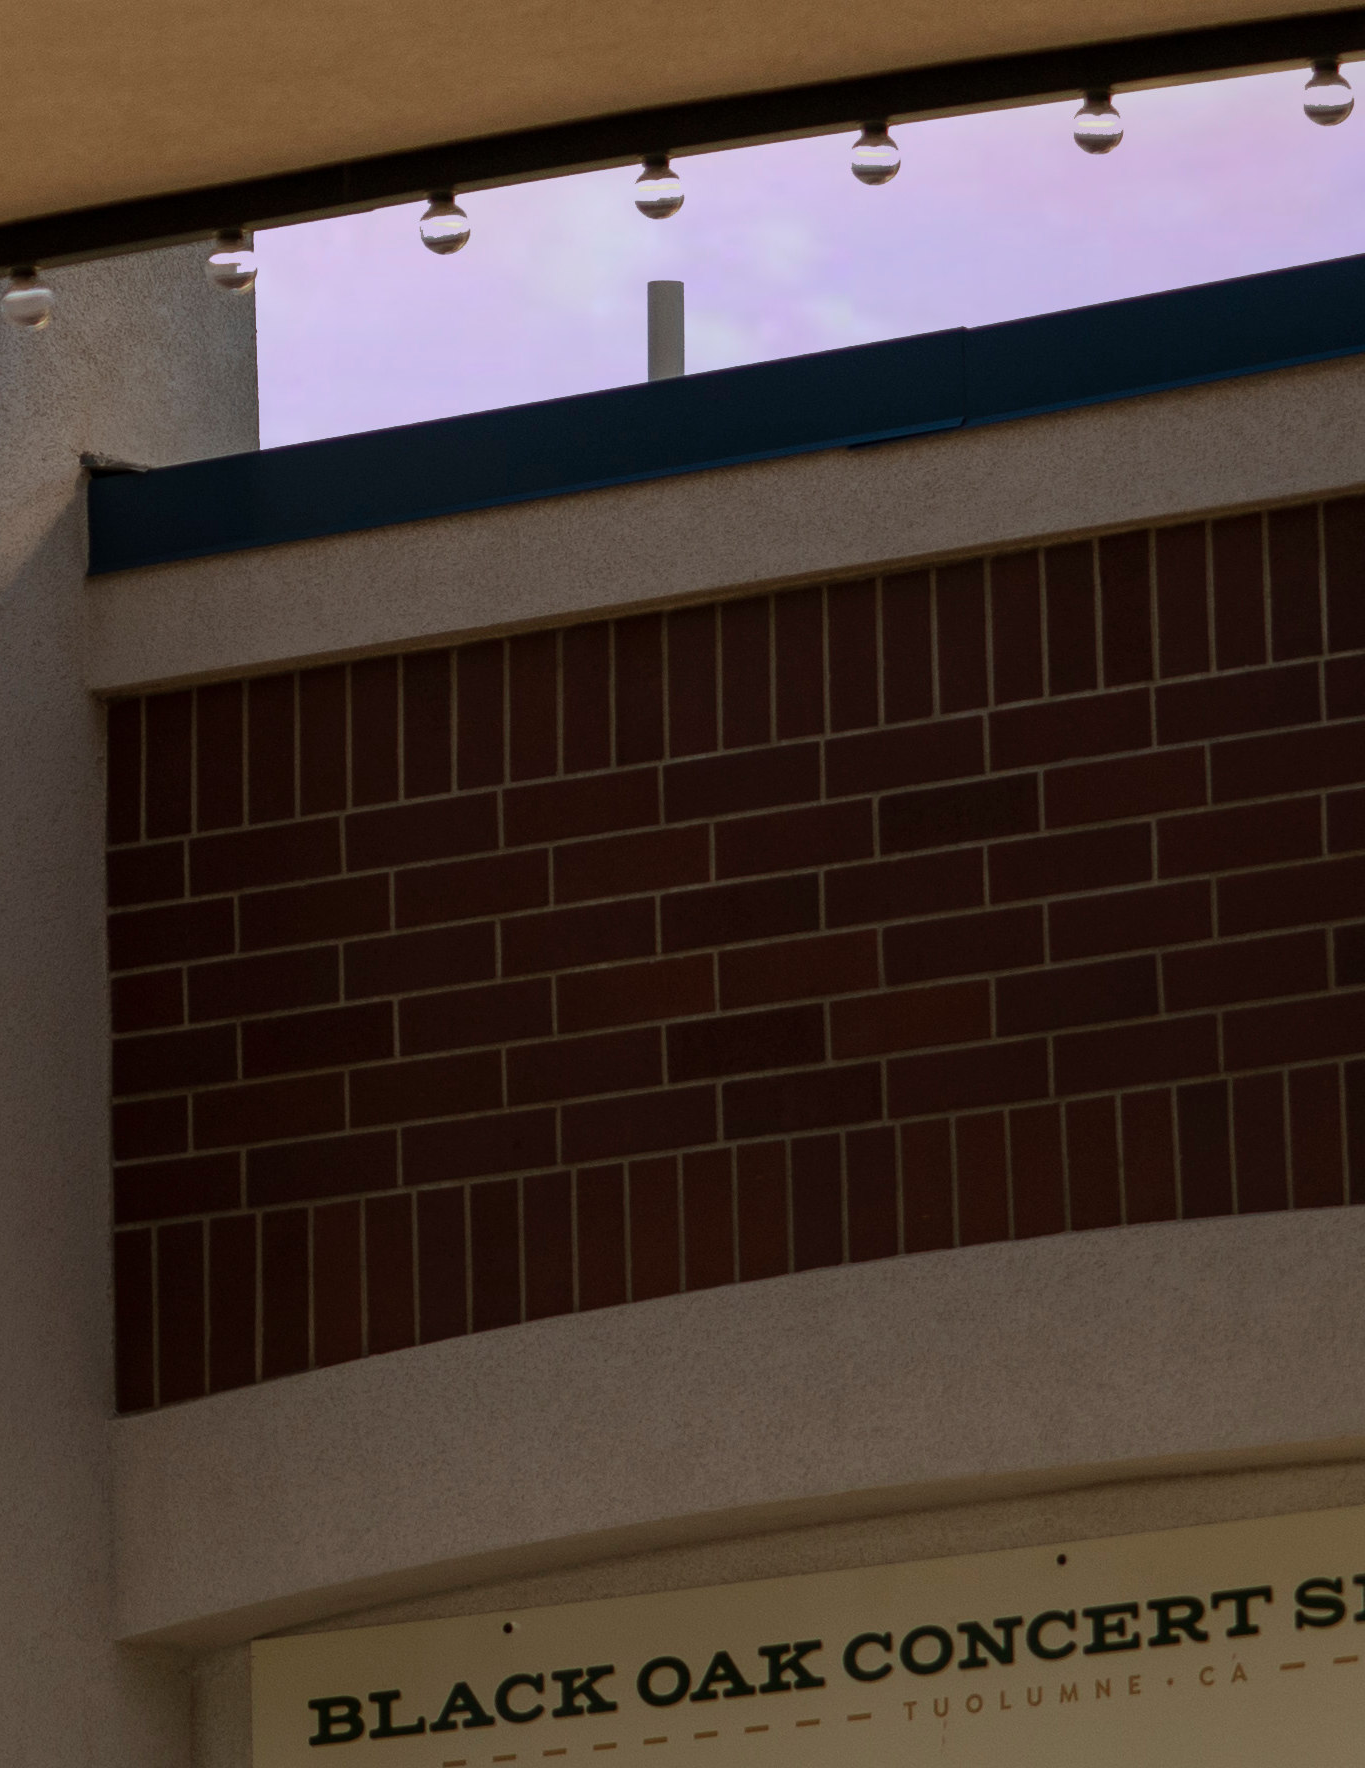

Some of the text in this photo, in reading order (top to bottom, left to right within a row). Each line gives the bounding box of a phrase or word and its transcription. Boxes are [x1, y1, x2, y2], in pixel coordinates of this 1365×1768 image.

[308, 1573, 1365, 1747] BLACK OAK CONCERT S
[903, 1663, 1248, 1722] TUOLUMNE CA
